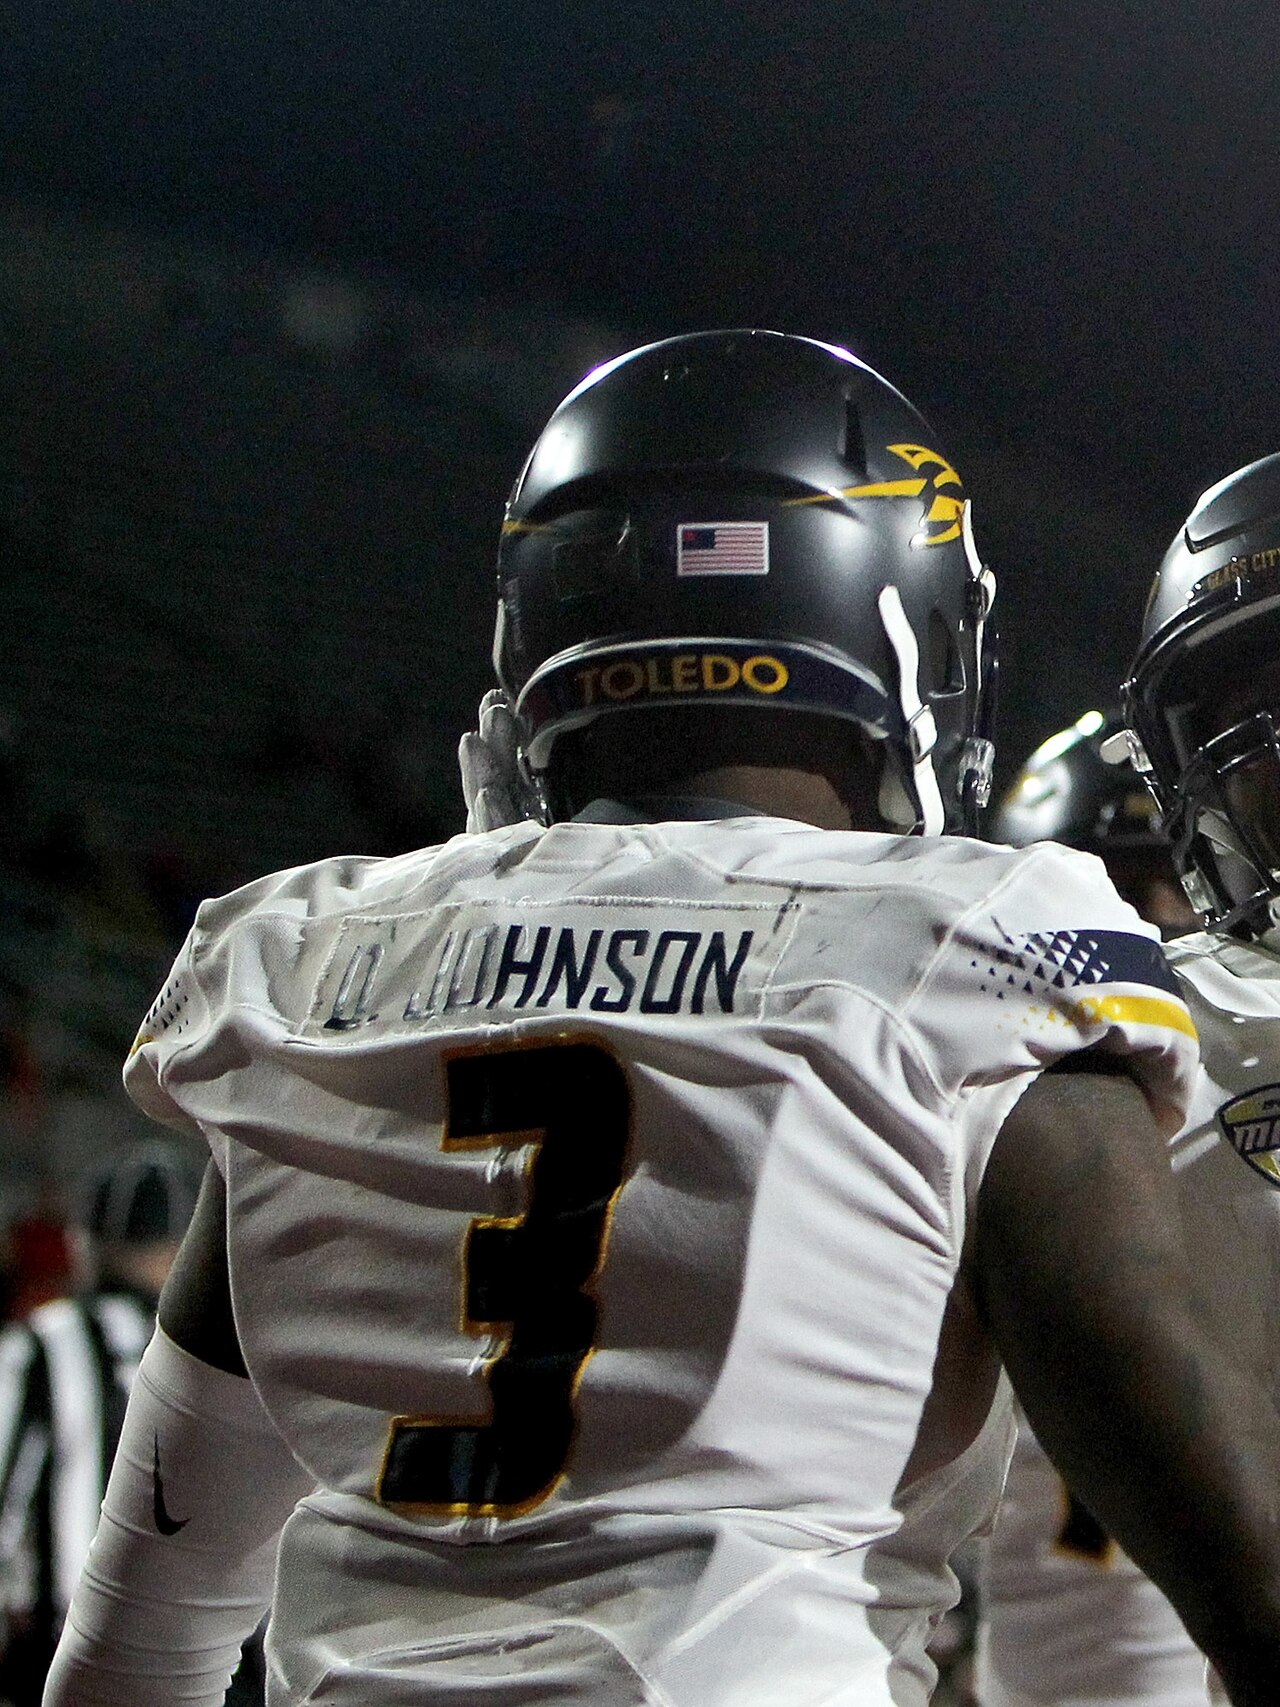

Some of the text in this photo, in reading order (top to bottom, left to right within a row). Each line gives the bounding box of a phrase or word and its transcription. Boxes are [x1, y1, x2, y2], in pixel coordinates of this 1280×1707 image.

[577, 654, 790, 704] TOLEDO
[402, 923, 755, 1022] JOHNSON
[377, 1031, 636, 1521] 3
